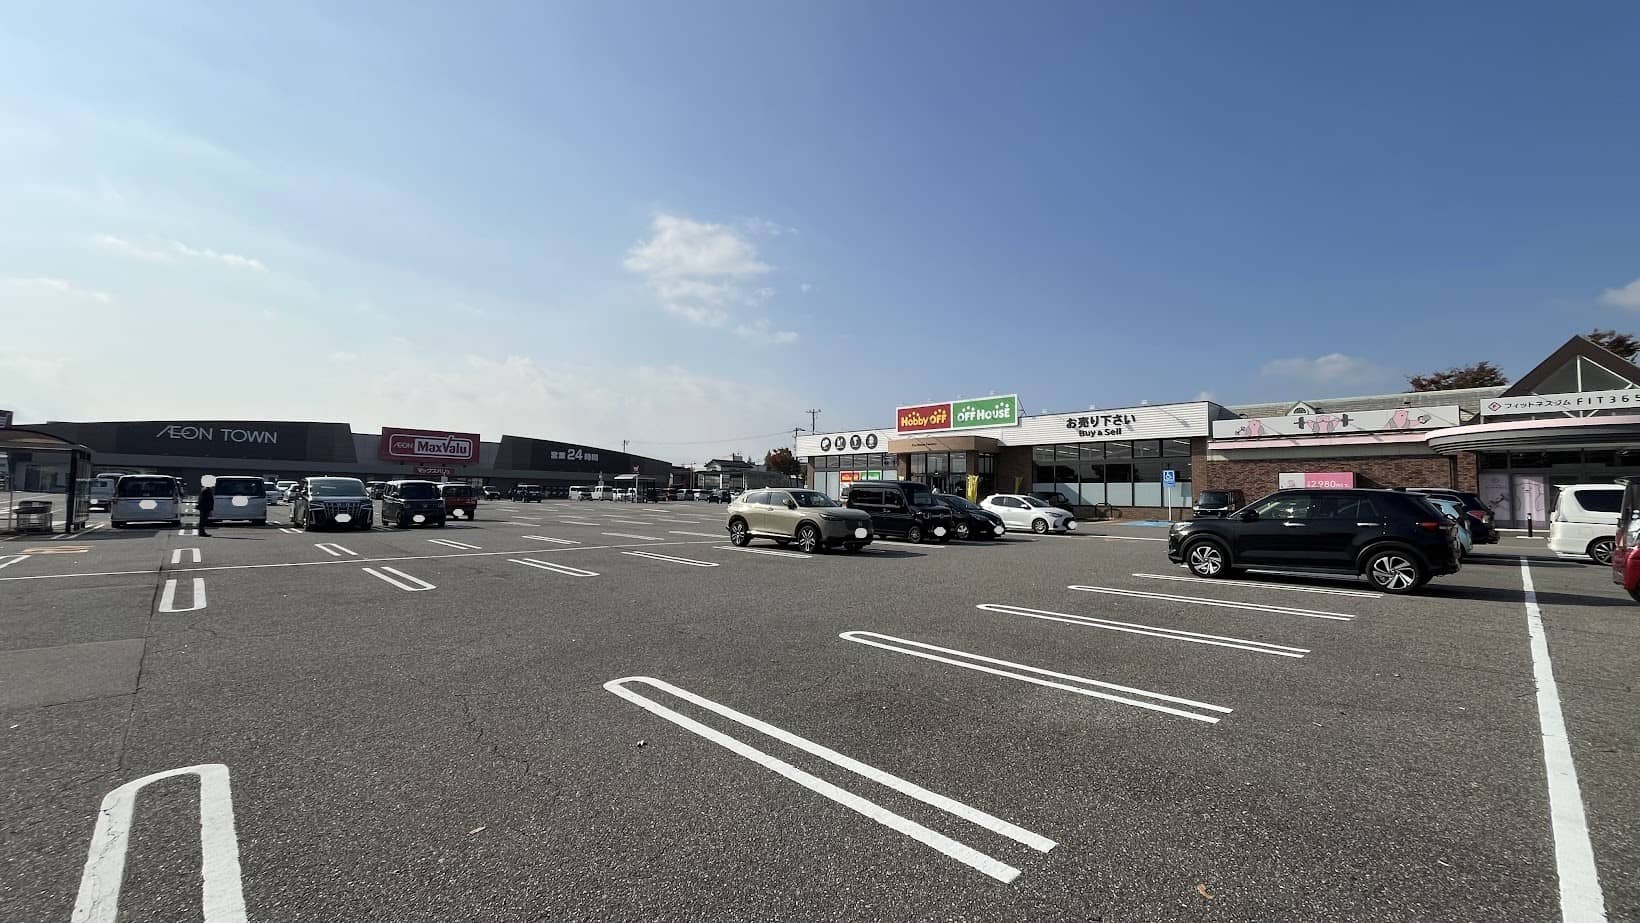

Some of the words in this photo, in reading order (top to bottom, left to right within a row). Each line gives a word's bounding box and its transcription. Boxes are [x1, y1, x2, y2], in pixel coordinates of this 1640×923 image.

[1504, 399, 1571, 409] フィットネスジム
[901, 415, 929, 427] Hobby
[930, 413, 948, 424] OFF
[957, 410, 976, 421] OFF
[1066, 414, 1136, 428] お売り下さい
[220, 428, 277, 444] TOWN
[1079, 429, 1096, 438] Buy
[1104, 427, 1122, 436] Sell
[417, 439, 467, 454] MaxValu
